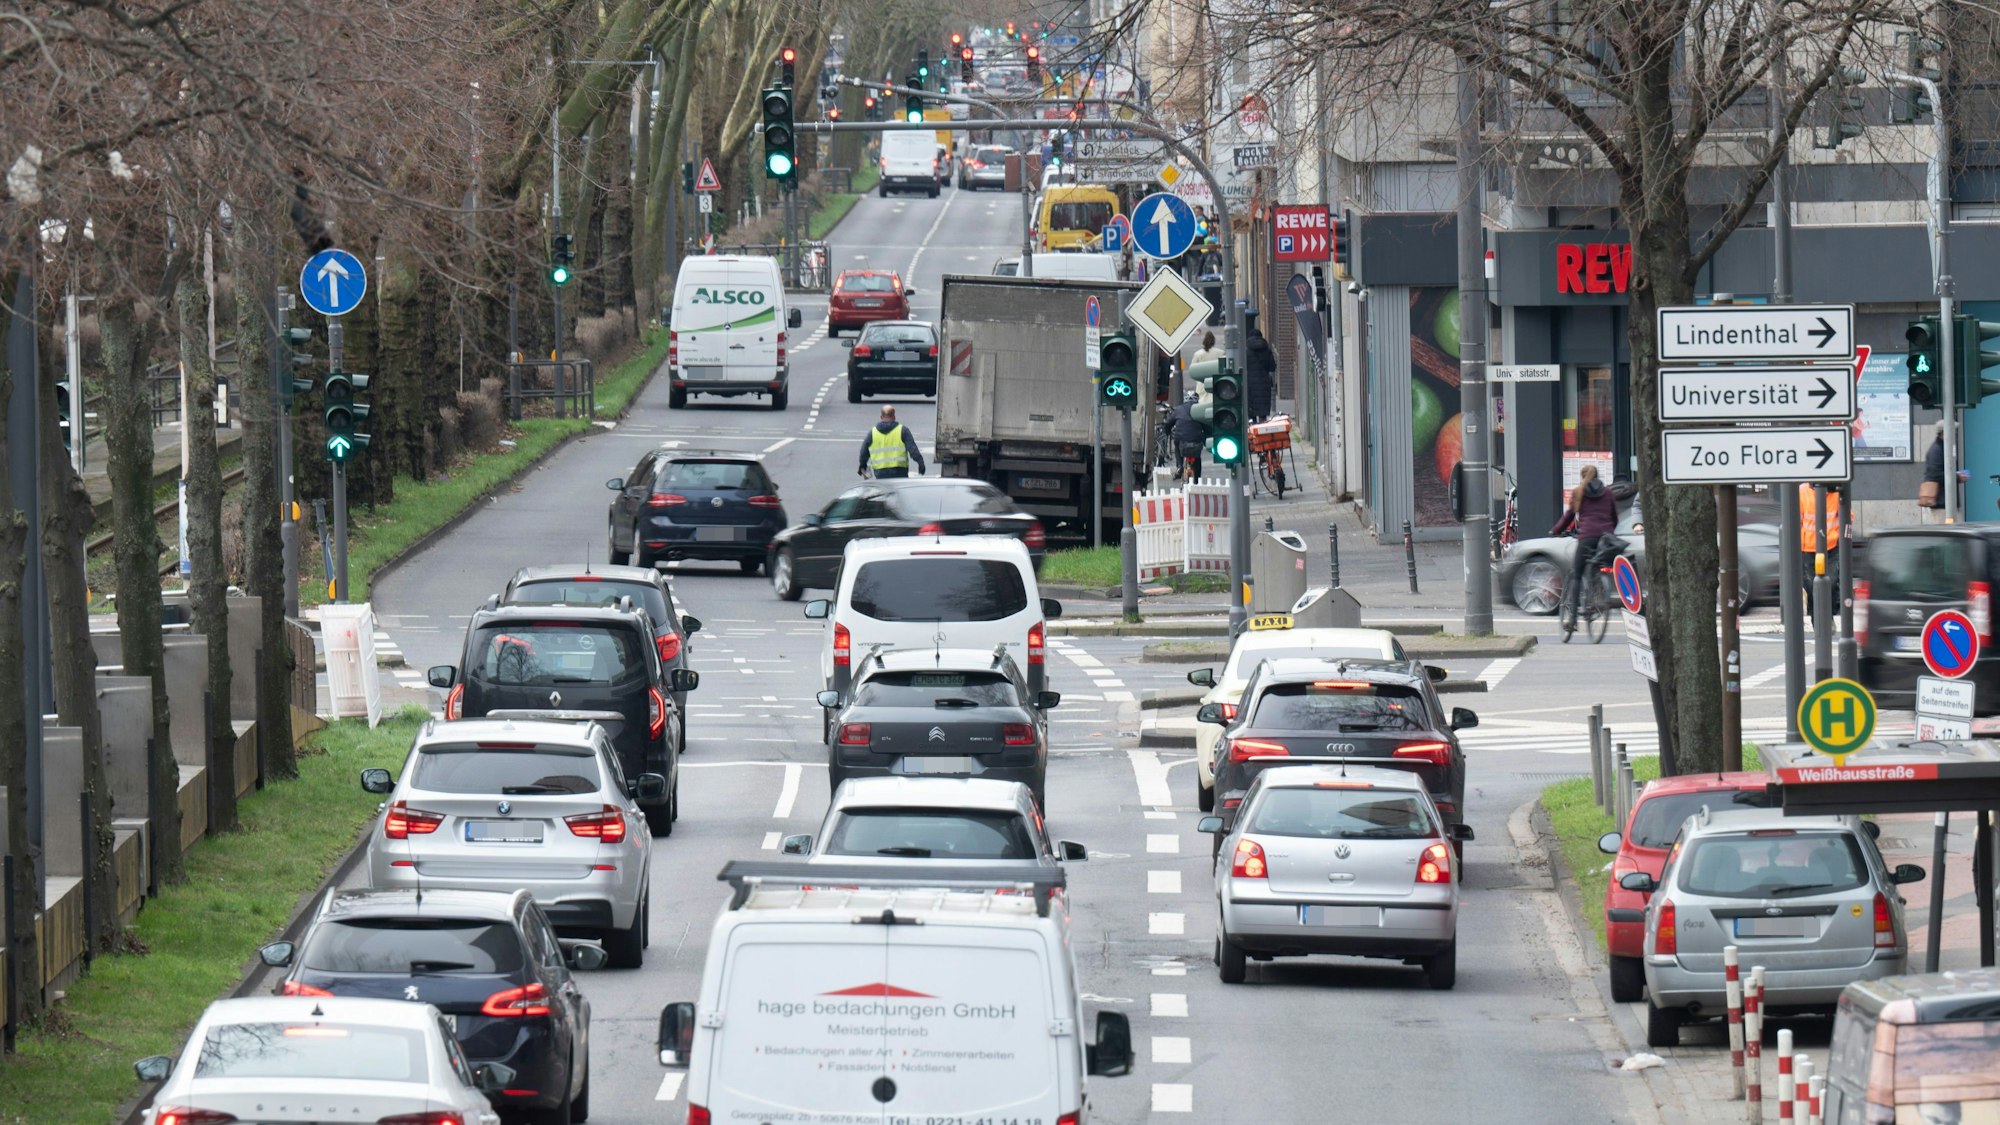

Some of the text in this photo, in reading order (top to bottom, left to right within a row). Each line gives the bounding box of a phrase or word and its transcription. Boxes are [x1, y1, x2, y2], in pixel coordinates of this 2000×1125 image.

[1219, 185, 1253, 196] LUMEN
[703, 198, 709, 210] 3
[1276, 213, 1327, 229] REWE
[1106, 228, 1118, 249] P
[1557, 243, 1632, 294] REW
[690, 287, 765, 305] ALSCO
[1676, 323, 1798, 345] Lindenthal
[1496, 368, 1552, 378] Univsitätsstr.
[1672, 384, 1799, 406] Universität
[1690, 444, 1798, 467] Zoo Flora
[1257, 617, 1287, 627] TAXI
[1931, 686, 1960, 697] auf dem
[1920, 695, 1969, 711] Seitenstreifen
[1798, 766, 1915, 782] Weißhausstraße
[757, 1000, 1016, 1021] hage bedachungen GmbH
[827, 1024, 929, 1037] Meisterbetrieb
[764, 1045, 893, 1057] Bedachungen aller Art
[911, 1048, 1015, 1060] Zimmererarbeiten
[827, 1061, 886, 1072] Fassaden
[900, 1063, 957, 1073] Notdienst
[730, 1109, 794, 1122] Georgsplatz
[855, 1113, 880, 1125] Köln
